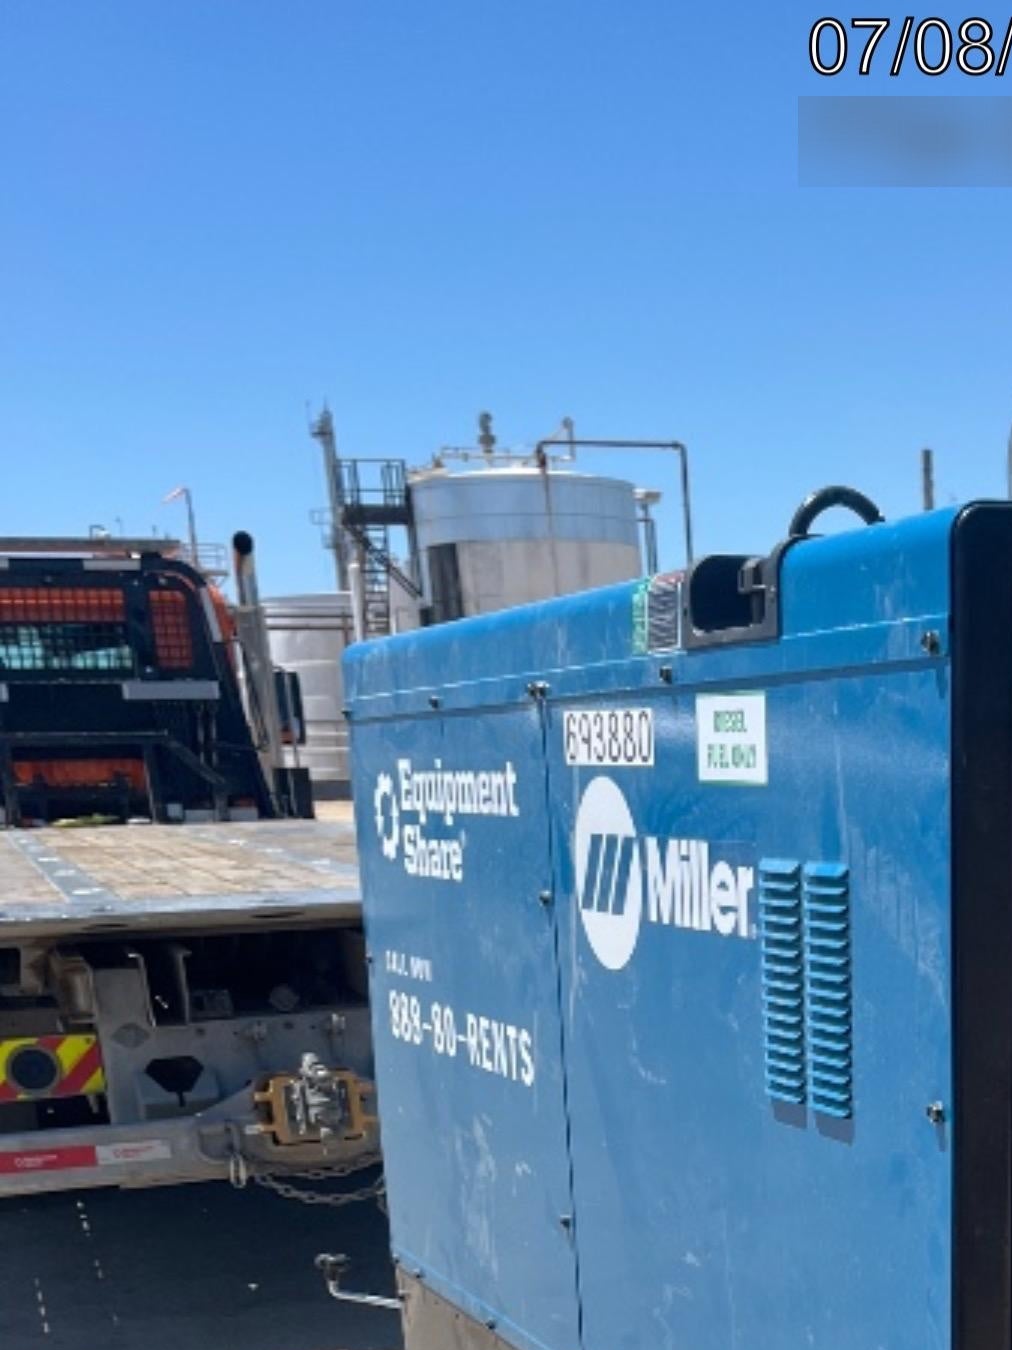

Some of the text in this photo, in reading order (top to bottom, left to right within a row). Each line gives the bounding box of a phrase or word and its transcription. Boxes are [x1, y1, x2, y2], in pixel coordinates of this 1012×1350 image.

[566, 711, 651, 763] 693880
[397, 757, 520, 826] Equipment
[404, 824, 464, 882] Share
[645, 836, 754, 938] Miller
